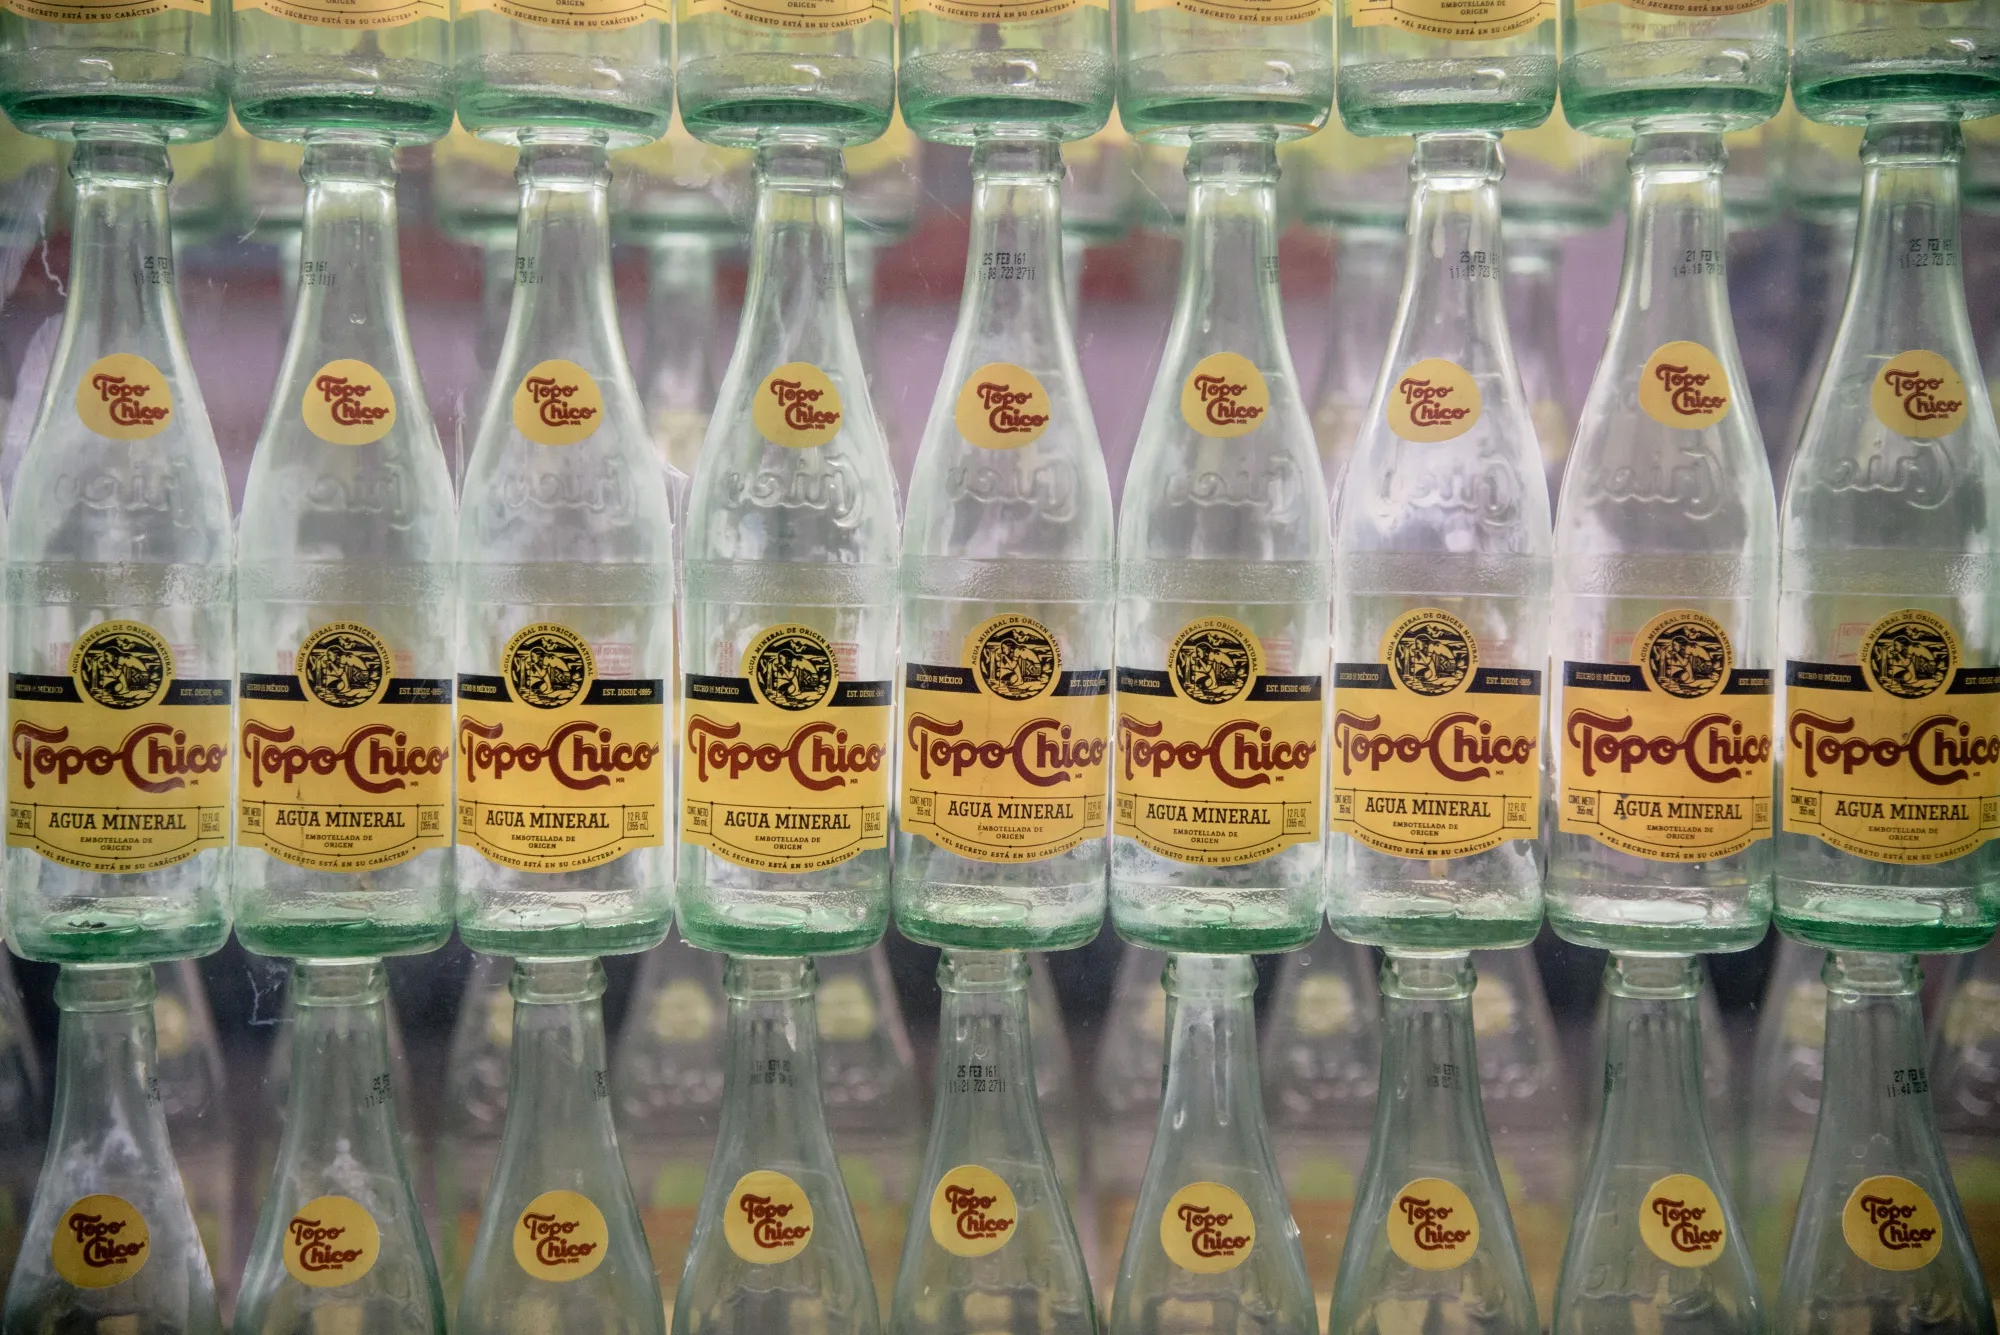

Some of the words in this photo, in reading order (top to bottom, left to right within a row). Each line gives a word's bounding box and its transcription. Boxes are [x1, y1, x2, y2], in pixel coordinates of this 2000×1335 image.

[28, 6, 58, 18] SECRETO
[1417, 23, 1452, 34] SECRETO
[1456, 27, 1474, 35] ESTÁ
[93, 373, 150, 401] Topo
[316, 375, 371, 402] Topo
[526, 376, 579, 403] Topo
[1194, 374, 1247, 400] Topo
[1400, 377, 1453, 404] Topo
[1656, 364, 1710, 391] Topo
[1884, 368, 1944, 396] Topo
[770, 379, 824, 406] Topo
[977, 382, 1032, 410] Topo
[1671, 387, 1726, 415] Chico
[1904, 392, 1962, 420] Chico
[110, 397, 169, 426] Chico
[331, 398, 389, 426] Chico
[540, 399, 597, 426] Chico
[785, 402, 840, 430] Chico
[989, 406, 1049, 433] Chico
[1206, 397, 1263, 425] Chico
[1410, 400, 1470, 426] Chico
[72, 655, 80, 674] AGUA
[79, 627, 110, 652] MINERAL
[127, 625, 155, 641] ORIGEN
[156, 640, 171, 676] NATURAL
[1393, 615, 1421, 640] MINERAL
[1436, 613, 1464, 630] ORIGEN
[1463, 629, 1478, 664] NATURAL
[12, 720, 121, 789] Topo
[120, 723, 227, 793] Chico
[242, 719, 346, 787] Topo
[344, 724, 449, 793] Chico
[460, 715, 549, 782] Topo
[548, 720, 659, 790] Chico
[688, 714, 790, 782] Topo
[788, 722, 886, 791] Chico
[908, 712, 1013, 779] Topo
[1012, 717, 1106, 787] Chico
[1118, 712, 1210, 780] Topo
[1209, 719, 1316, 789] Chico
[1335, 709, 1429, 776] Topo
[1428, 712, 1536, 781] Chico
[1567, 708, 1686, 777] Topo
[1684, 713, 1771, 783] Chico
[1789, 709, 1910, 778] Topo
[1909, 714, 2000, 785] Chico
[276, 810, 320, 826] AGUA
[326, 811, 405, 827] MINERAL
[486, 810, 526, 827] AGUA
[530, 812, 609, 828] MINERAL
[725, 811, 768, 828] AGUA
[775, 813, 850, 829] MINERAL
[948, 800, 991, 817] AGUA
[998, 803, 1073, 819] MINERAL
[1146, 803, 1187, 822] AGUA
[1192, 806, 1270, 824] MINERAL
[1365, 797, 1407, 814] AGUA
[1412, 800, 1491, 817] MINERAL
[1614, 800, 1663, 817] AGUA
[1668, 803, 1742, 819] MINERAL
[1835, 801, 1885, 819] AGUA
[1890, 804, 1969, 820] MINERAL
[49, 813, 95, 829] AGUA
[102, 814, 186, 830] MINERAL
[1174, 828, 1226, 836] EMBOTELLADA
[1393, 821, 1446, 829] EMBOTELLADA
[1647, 825, 1701, 833] EMBOTELLADA
[1869, 826, 1926, 834] EMBOTELLADA
[492, 852, 521, 866] SECRETO
[524, 860, 542, 868] ESTÁ
[955, 842, 988, 856] SECRETO
[991, 850, 1010, 859] ESTÁ
[1372, 838, 1402, 853] SECRETO
[1406, 847, 1424, 855] ESTÁ
[56, 855, 91, 870] SECRETO
[958, 1065, 966, 1078] 25
[970, 1065, 982, 1078] FEB
[740, 1194, 794, 1223] Topo
[945, 1185, 997, 1214] Topo
[1399, 1196, 1453, 1225] Topo
[1653, 1198, 1706, 1226] Topo
[1860, 1196, 1916, 1224] Topo
[69, 1213, 126, 1242] Topo
[290, 1217, 345, 1245] Topo
[524, 1212, 580, 1240] Topo
[957, 1210, 1014, 1239] Chico
[1178, 1204, 1233, 1232] Topo
[754, 1218, 810, 1248] Chico
[1192, 1228, 1250, 1258] Chico
[1414, 1220, 1471, 1250] Chico
[1671, 1222, 1722, 1252] Chico
[1879, 1220, 1936, 1250] Chico
[83, 1238, 145, 1267] Chico
[300, 1242, 363, 1271] Chico
[536, 1236, 597, 1266] Chico
